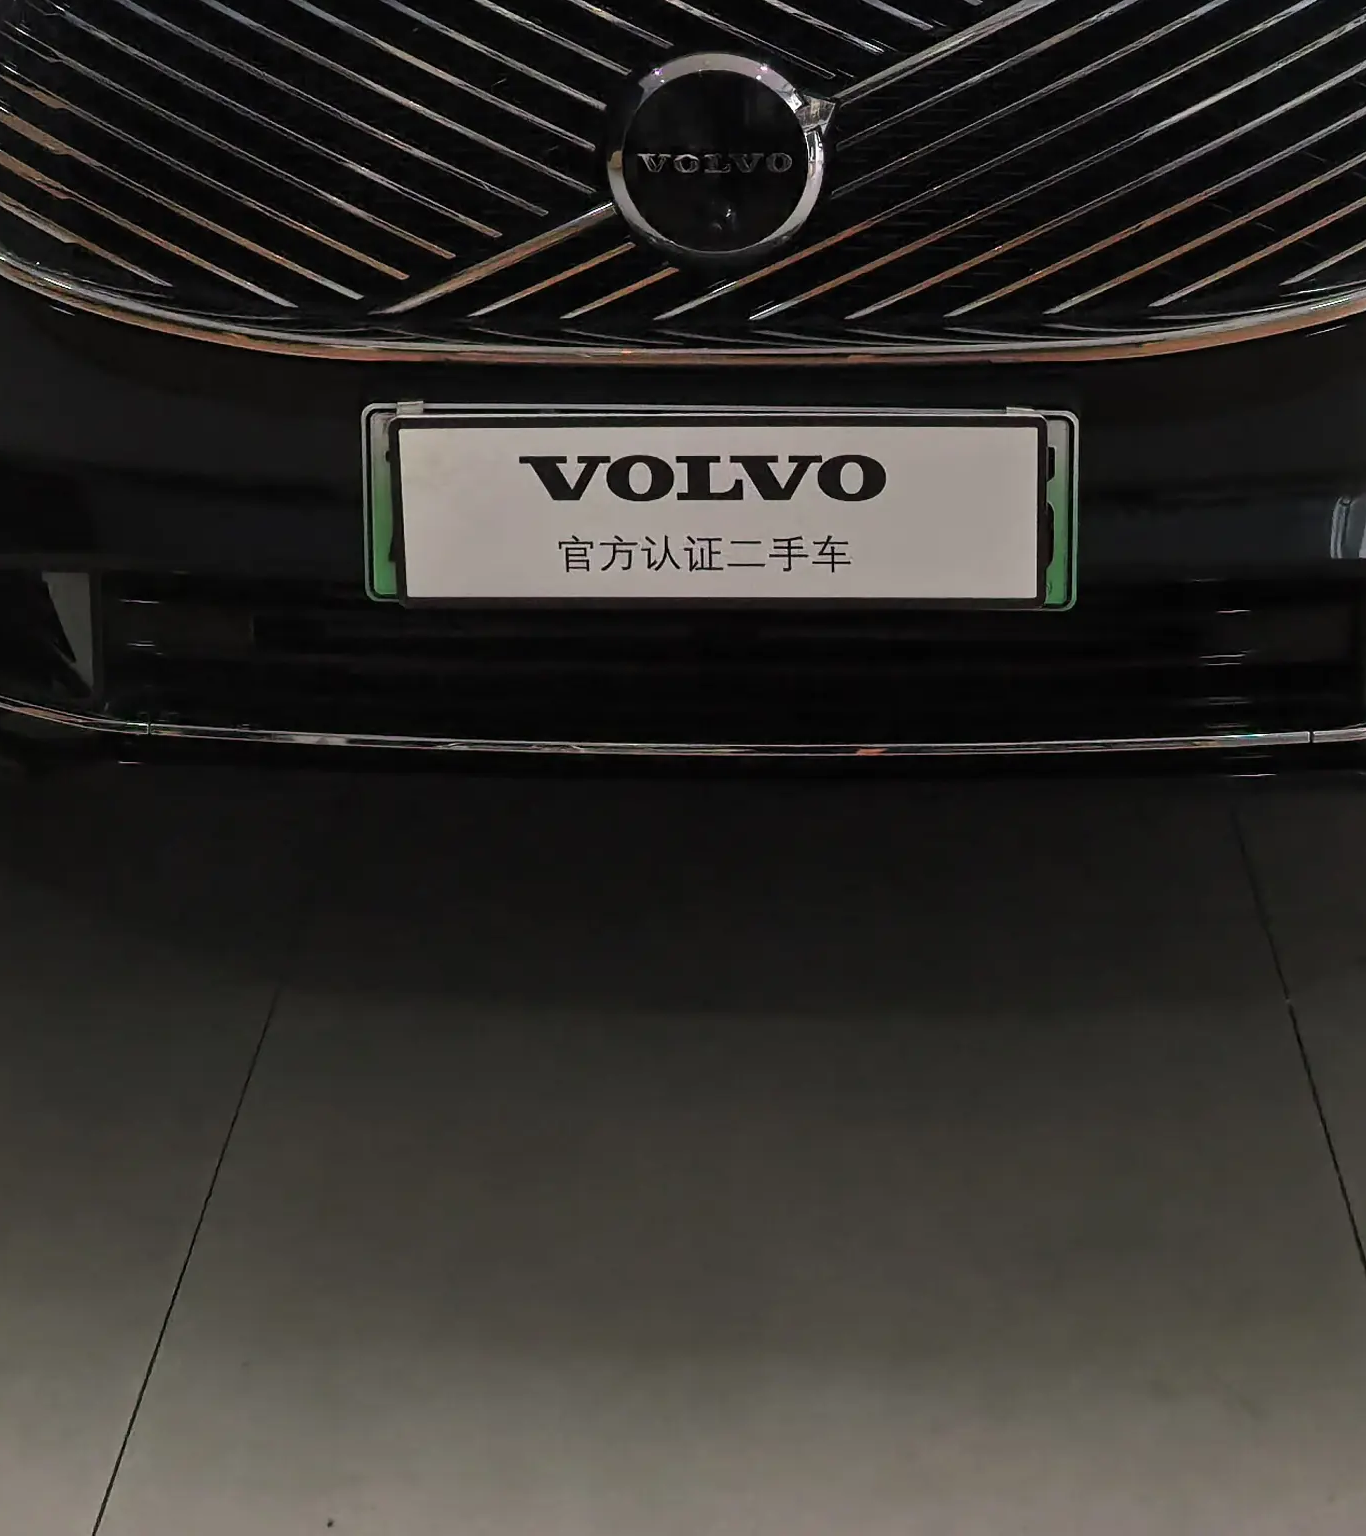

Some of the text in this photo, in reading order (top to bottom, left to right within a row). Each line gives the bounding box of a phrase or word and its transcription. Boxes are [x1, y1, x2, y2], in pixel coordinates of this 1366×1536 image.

[637, 152, 793, 173] VOLVO
[519, 454, 887, 502] VOLVO
[558, 535, 852, 573] 官方认证二手车
